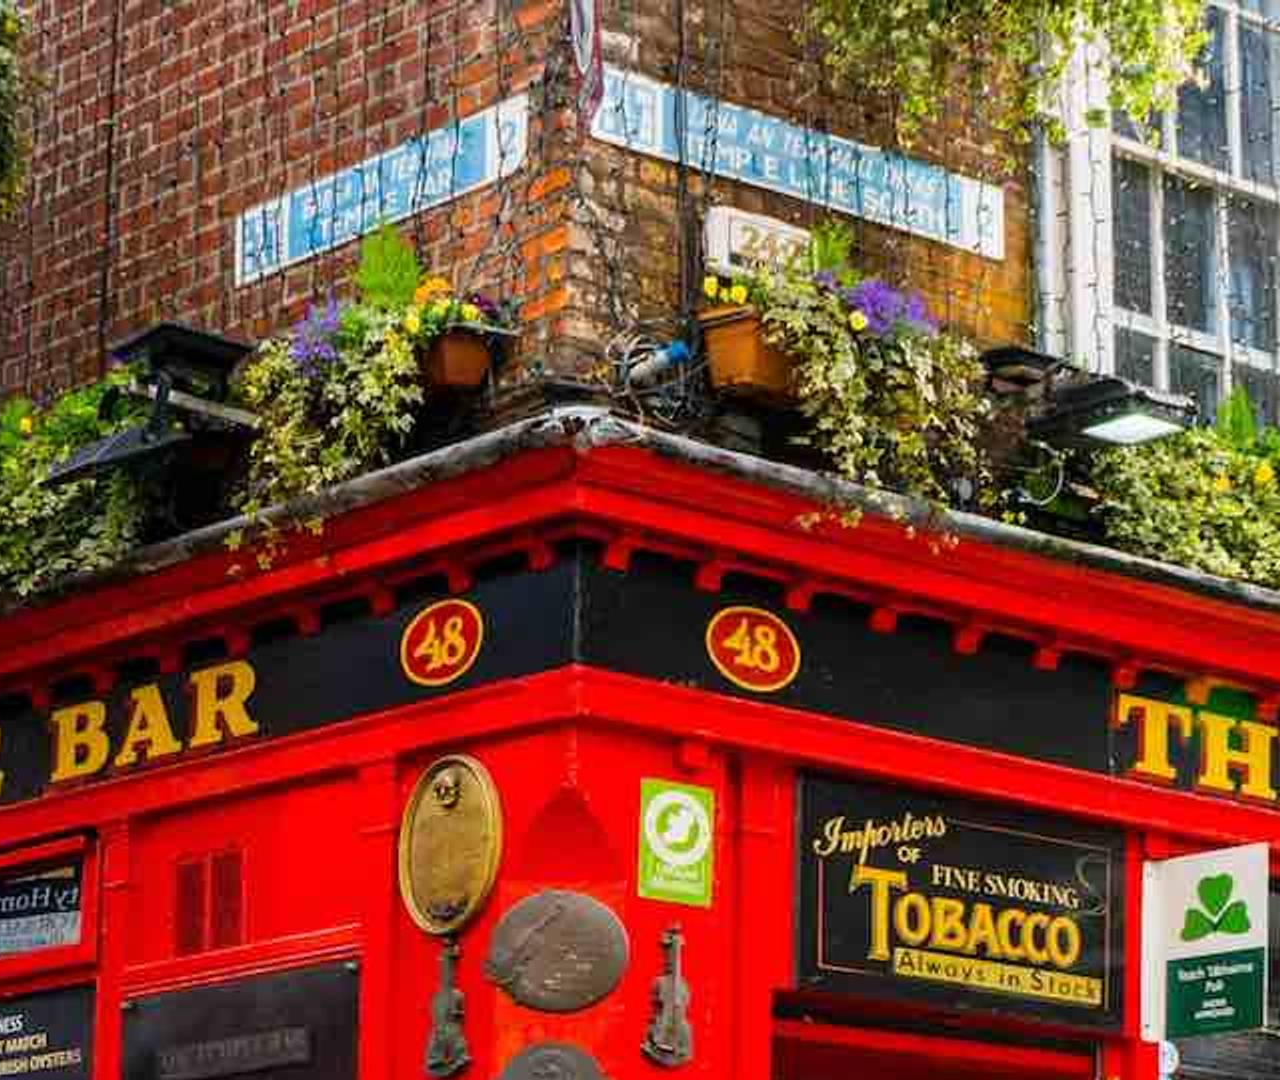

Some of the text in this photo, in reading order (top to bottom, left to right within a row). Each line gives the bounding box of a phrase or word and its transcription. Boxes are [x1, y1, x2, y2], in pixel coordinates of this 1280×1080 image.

[694, 137, 782, 179] TEMPE
[416, 615, 467, 674] 48
[720, 617, 782, 675] 48
[48, 659, 259, 783] BAR
[813, 811, 948, 865] Importers
[897, 845, 922, 864] OF
[931, 863, 1081, 909] FINE SMOKING
[848, 863, 1084, 968] TOBACCO
[897, 950, 1097, 999] Always in Stock
